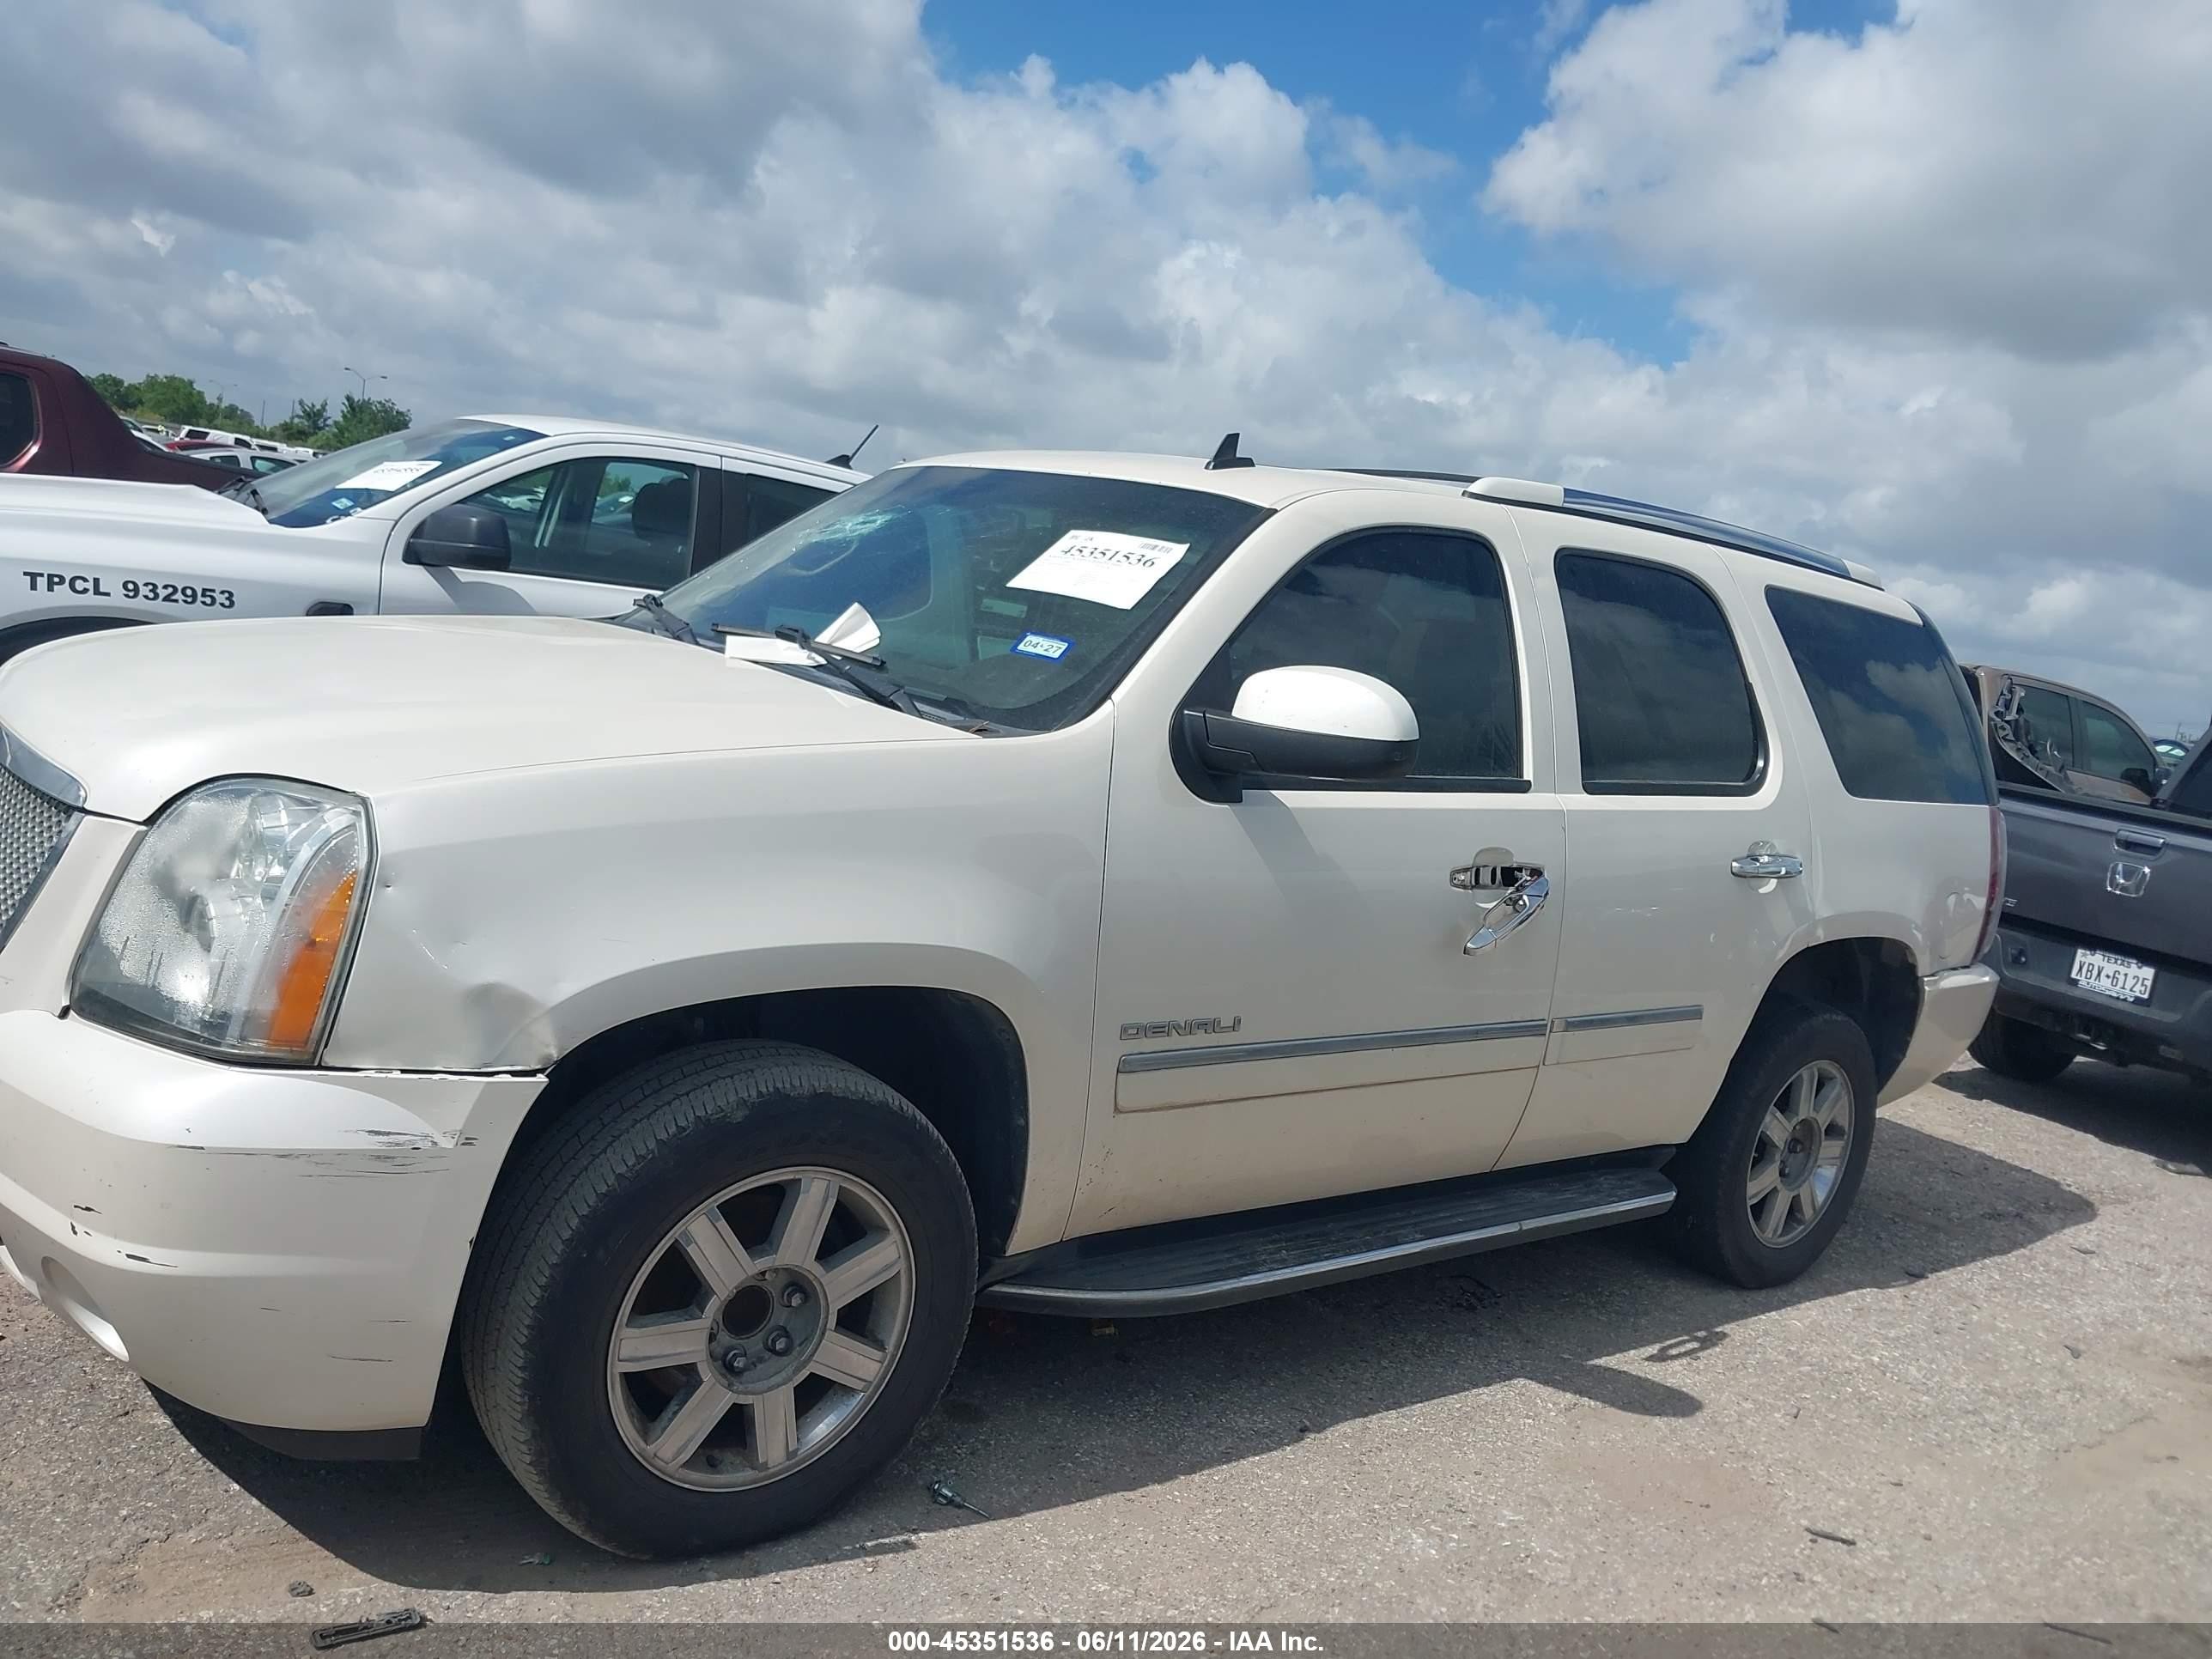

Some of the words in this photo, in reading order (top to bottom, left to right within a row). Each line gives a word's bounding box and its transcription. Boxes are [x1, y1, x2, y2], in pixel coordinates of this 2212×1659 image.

[1060, 544, 1158, 568] 45351536
[22, 571, 112, 597] TPCL
[121, 580, 236, 609] 932953
[2100, 954, 2131, 969] TEXAS
[1119, 1016, 1242, 1041] DENALI
